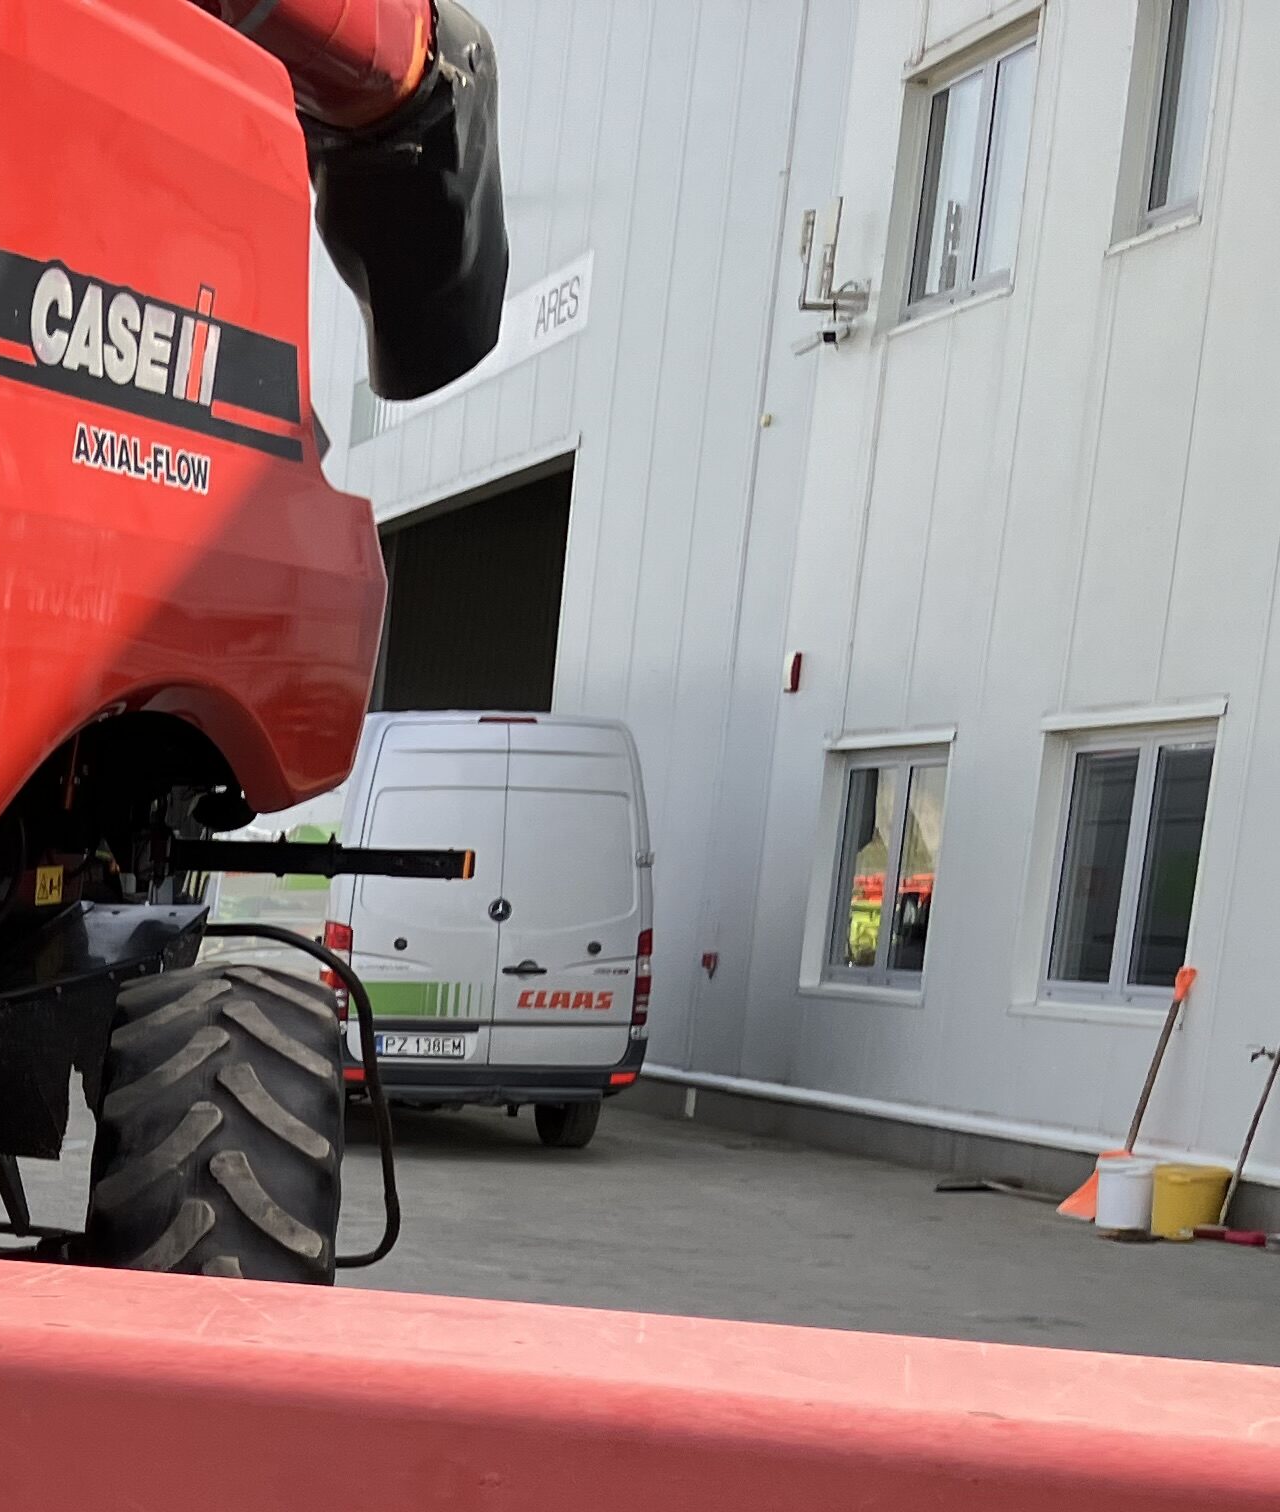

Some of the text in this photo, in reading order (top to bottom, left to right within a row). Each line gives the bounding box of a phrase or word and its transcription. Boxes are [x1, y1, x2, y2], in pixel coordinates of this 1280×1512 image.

[30, 266, 177, 395] CASE
[72, 422, 211, 494] AXIAL-FLOW
[517, 989, 613, 1010] CLAAS
